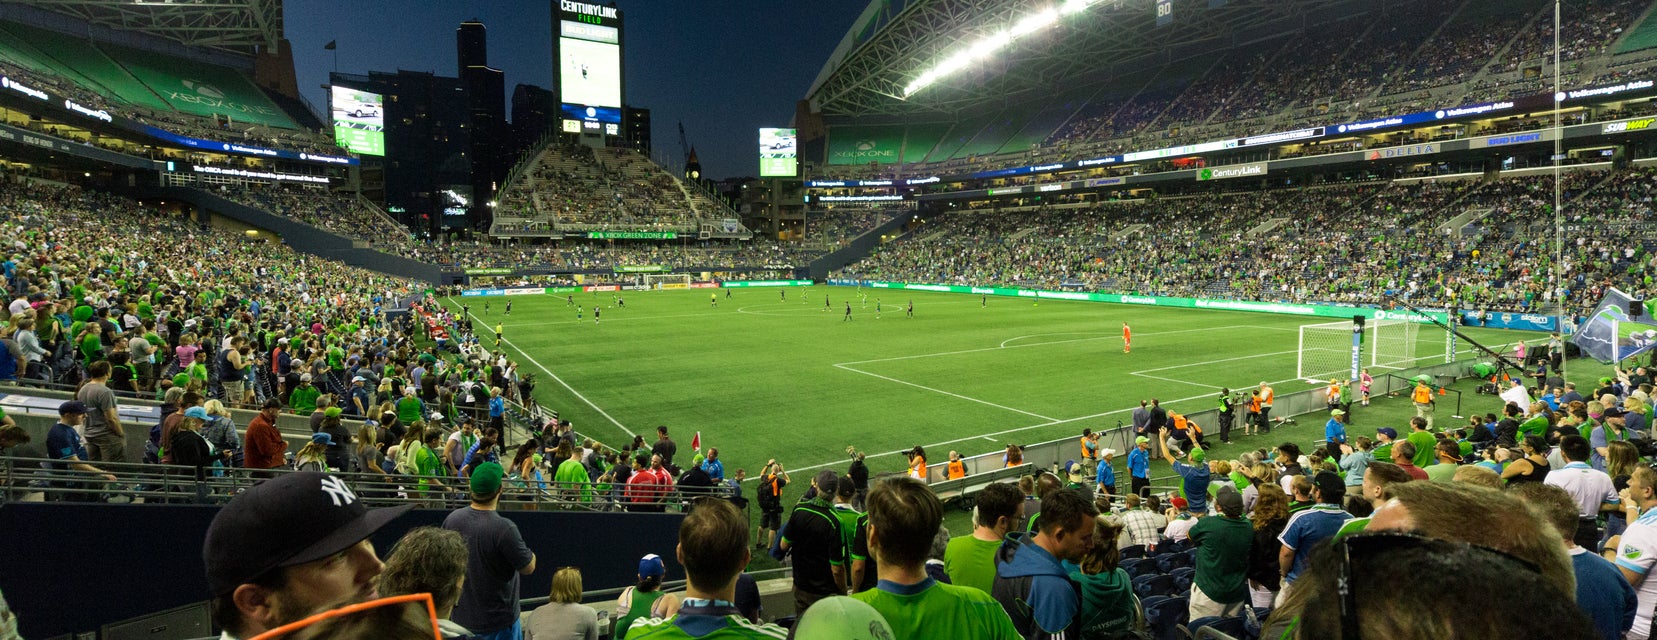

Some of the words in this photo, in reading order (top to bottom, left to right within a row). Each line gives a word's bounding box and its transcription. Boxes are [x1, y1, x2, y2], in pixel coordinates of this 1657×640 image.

[560, 0, 617, 19] CENTURYLINK
[1157, 2, 1171, 17] 80
[578, 14, 601, 24] FIELD
[1569, 84, 1626, 99] Volkswagen
[1626, 80, 1654, 90] Atlas
[1447, 105, 1492, 116] Volkswagen
[1492, 101, 1514, 110] Atlas
[1347, 120, 1385, 131] Volkswagen
[1385, 118, 1403, 126] Atlas
[1604, 118, 1656, 133] SUBWAY
[1488, 136, 1509, 146] BUD
[1510, 133, 1541, 143] LIGHT
[867, 149, 895, 157] ONE
[1386, 145, 1433, 158] DELTA
[1212, 165, 1261, 178] CenturyLink
[1467, 310, 1493, 320] slam
[1521, 314, 1548, 324] slalom
[321, 475, 356, 507] NY
